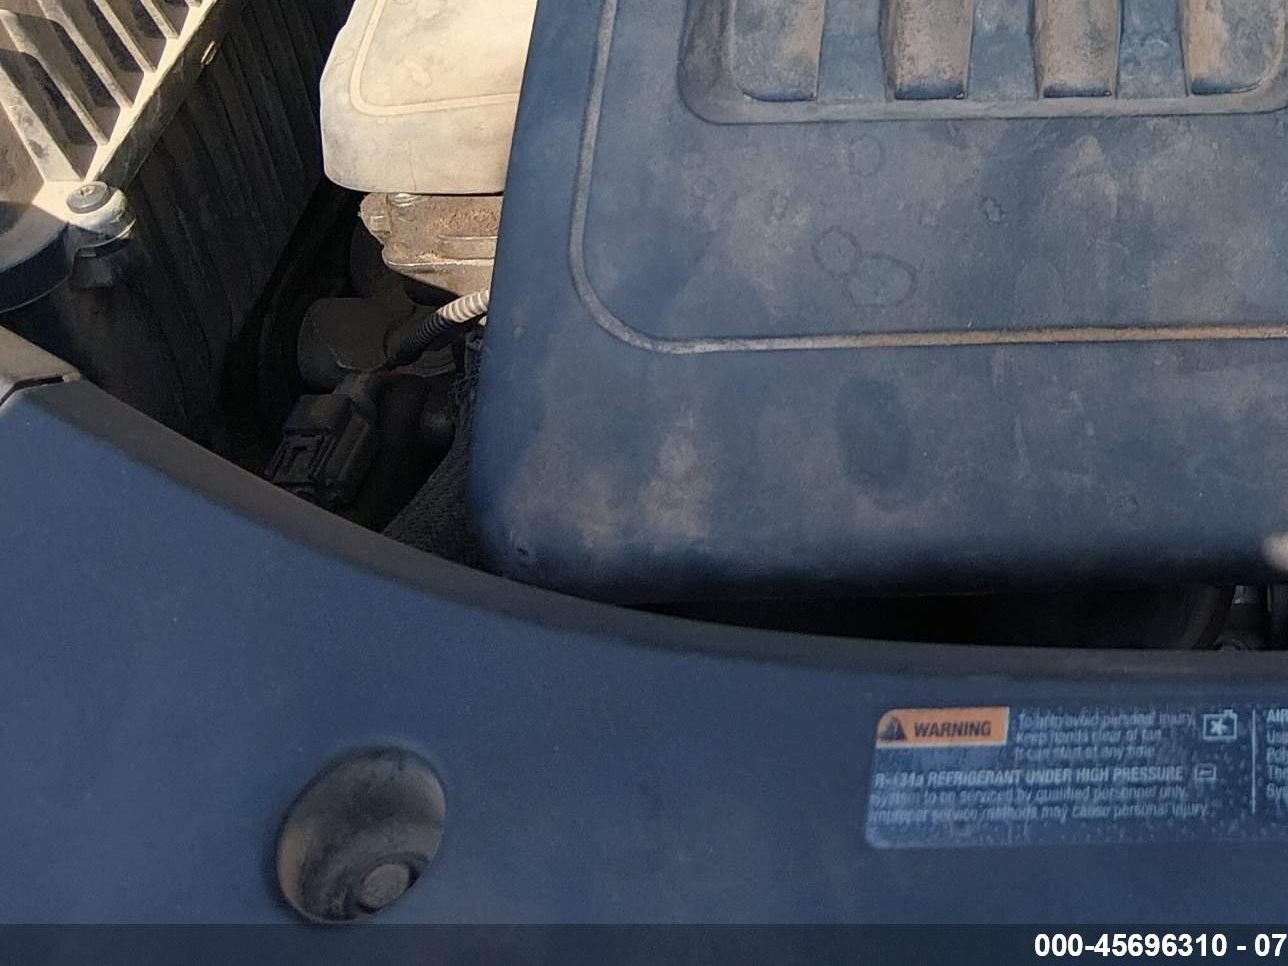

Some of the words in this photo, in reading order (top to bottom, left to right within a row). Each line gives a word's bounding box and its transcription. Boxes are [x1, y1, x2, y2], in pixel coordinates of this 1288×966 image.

[1267, 708, 1288, 722] AIR
[914, 721, 992, 738] WARNING
[875, 771, 924, 788] R-134a
[927, 768, 1022, 786] REFRIGERANT
[1025, 768, 1072, 784] UNDER
[1076, 767, 1109, 782] HIGH
[1113, 765, 1184, 782] PRESSURE
